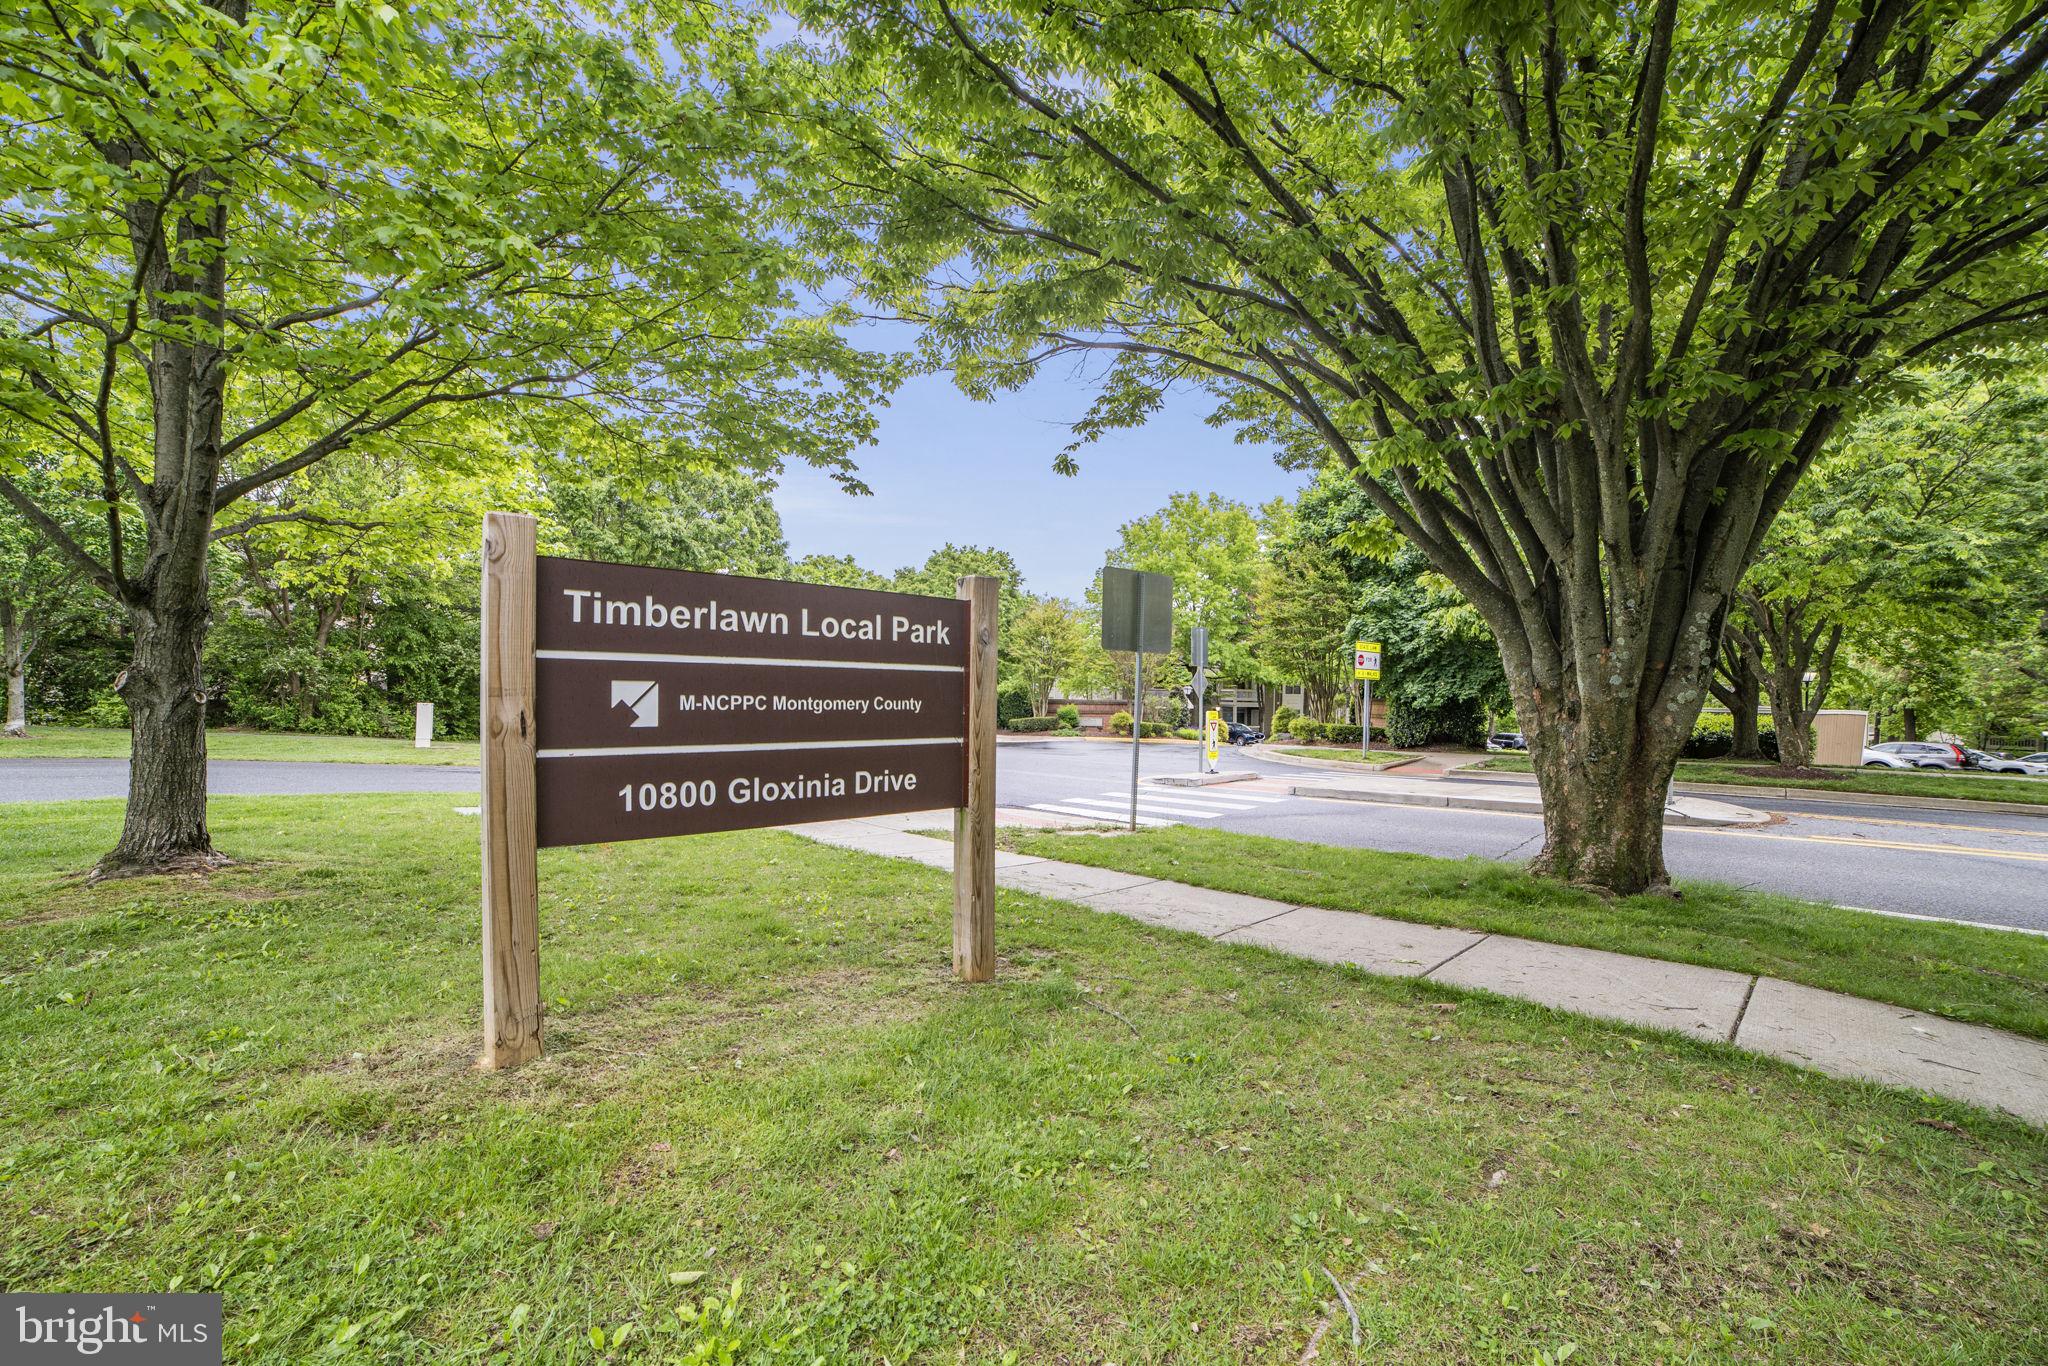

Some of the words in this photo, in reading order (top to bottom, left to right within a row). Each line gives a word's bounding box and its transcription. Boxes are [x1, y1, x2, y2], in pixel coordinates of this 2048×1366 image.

[563, 589, 789, 635] Timberlawn
[801, 608, 882, 641] Local
[892, 615, 951, 645] Park
[679, 694, 767, 711] M-NCPPC
[773, 695, 870, 714] Montgomery
[873, 696, 922, 714] County
[618, 779, 717, 812] 10800
[728, 773, 846, 804] Gloxinia
[855, 769, 917, 794] Drive
